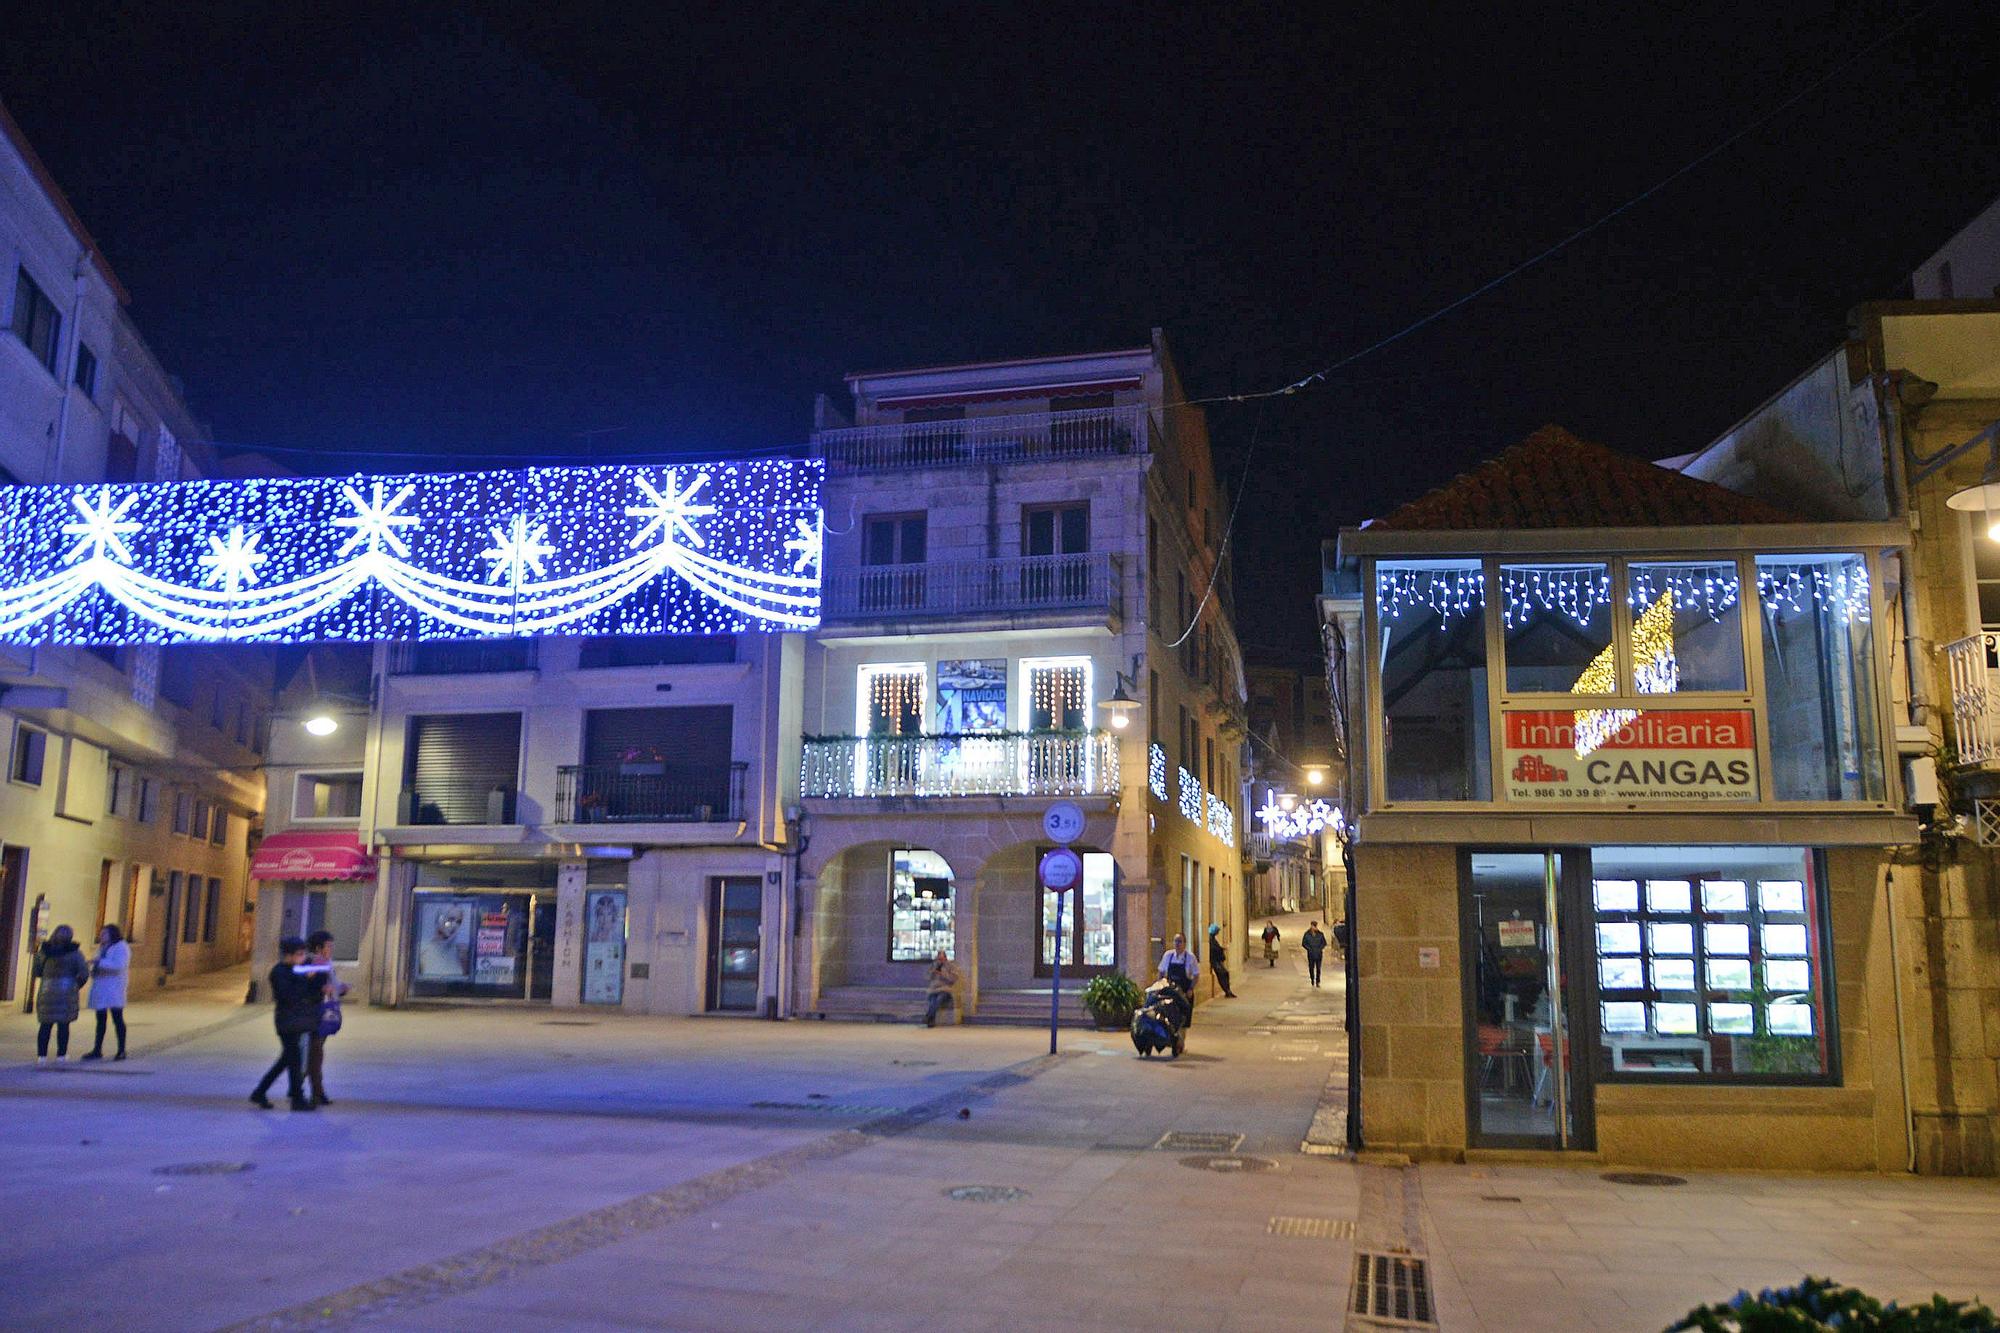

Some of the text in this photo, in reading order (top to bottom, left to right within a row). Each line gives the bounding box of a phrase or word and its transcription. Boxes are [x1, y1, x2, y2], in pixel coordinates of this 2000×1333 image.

[963, 689, 1006, 702] NAVIDAD
[1520, 718, 1737, 745] inmbiliaria
[1586, 759, 1750, 786] CANGAS
[1511, 788, 1531, 798] Tel.
[1534, 788, 1556, 798] 986
[1559, 788, 1572, 798] 30
[1575, 788, 1589, 798] 39
[1617, 788, 1751, 799] www.inmocangas.com
